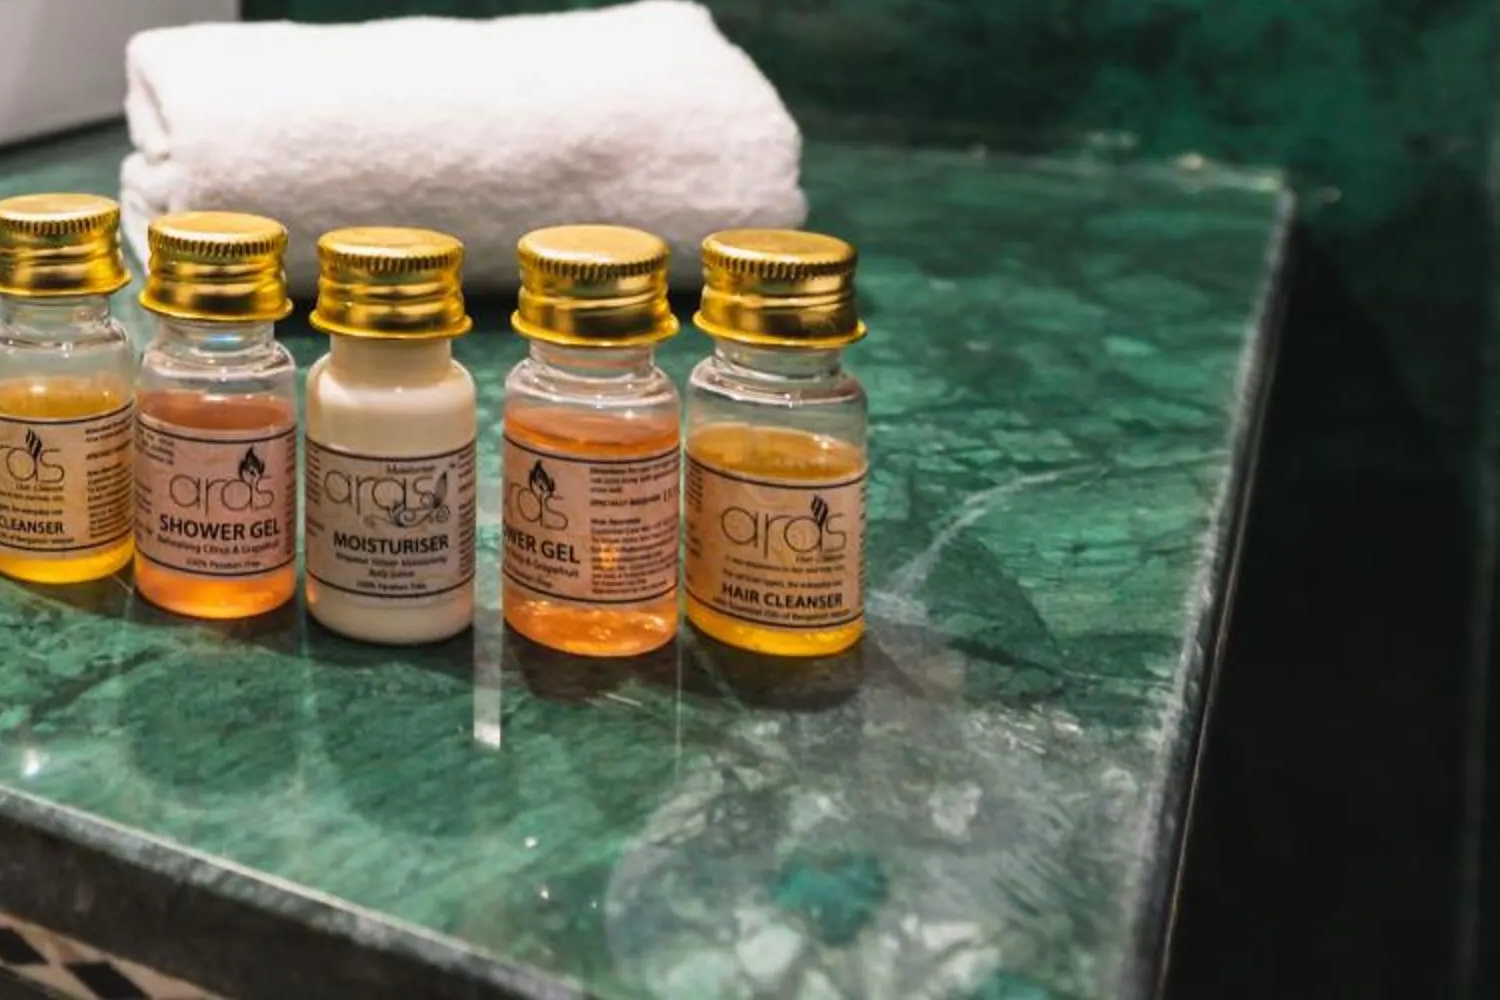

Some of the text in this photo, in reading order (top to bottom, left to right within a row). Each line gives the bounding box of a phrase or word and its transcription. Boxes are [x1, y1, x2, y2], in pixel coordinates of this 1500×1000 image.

[169, 474, 275, 515] aras
[509, 482, 569, 531] ras
[159, 513, 246, 541] SHOWER
[249, 517, 281, 539] GEL
[721, 506, 847, 559] aras
[333, 530, 449, 555] MOISTURISER
[541, 539, 581, 564] GEL
[721, 583, 760, 605] HAIR
[763, 591, 843, 609] CLEANSER
